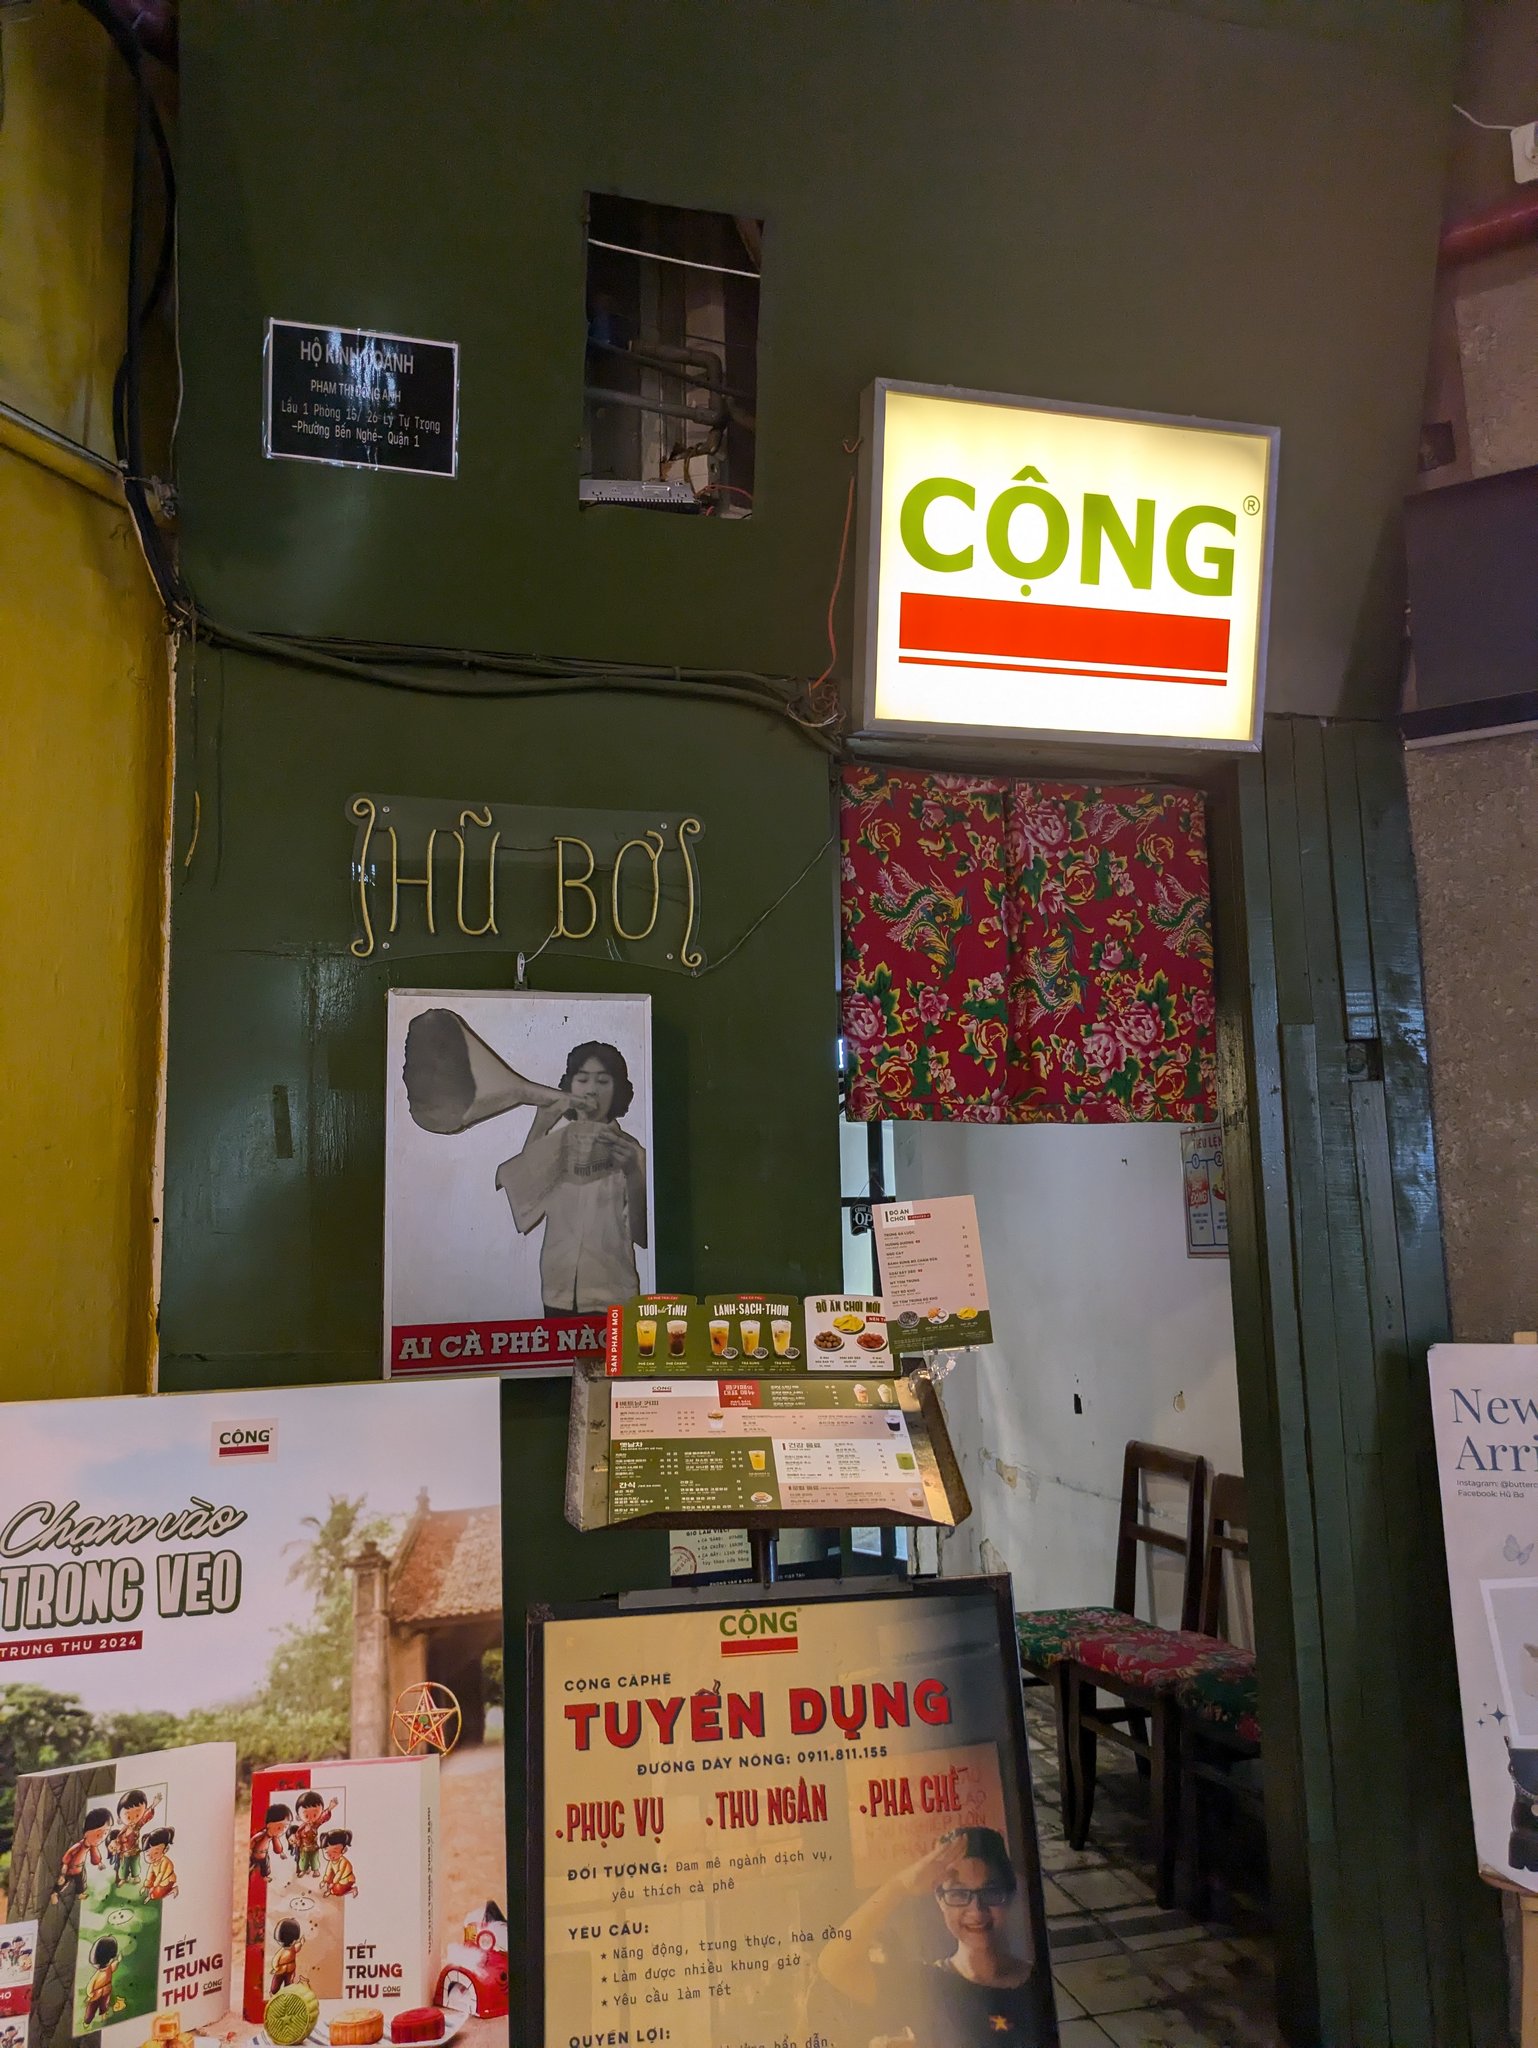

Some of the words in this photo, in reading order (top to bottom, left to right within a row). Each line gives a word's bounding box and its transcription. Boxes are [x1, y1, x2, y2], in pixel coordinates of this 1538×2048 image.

[300, 337, 322, 367] HỘ
[311, 380, 337, 397] PHẠM
[303, 403, 309, 415] 1
[313, 404, 341, 421] Phòng
[415, 416, 441, 434] Trọng
[335, 422, 351, 439] Bến
[388, 431, 409, 448] Quận
[414, 435, 420, 447] 1
[900, 465, 1236, 597] CỘNG
[399, 1337, 432, 1360] AI
[440, 1329, 483, 1358] CÀ
[491, 1325, 549, 1354] PHÊ
[220, 1428, 269, 1447] CỘNG
[0, 1499, 158, 1558] Chạm
[157, 1496, 248, 1542] vào
[0, 1556, 145, 1632] TRONG
[157, 1549, 242, 1618] VEO
[720, 1609, 797, 1638] CỘNG
[0, 1641, 54, 1658] TRUNG
[61, 1638, 93, 1652] THU
[100, 1635, 137, 1650] 2024
[564, 1680, 766, 1751] TUYỂN
[789, 1678, 952, 1741] DỤNG
[797, 1745, 888, 1764] 0911.811.155
[715, 1789, 759, 1829] THU
[767, 1776, 828, 1826] NGÂN
[868, 1777, 915, 1818] PHA
[920, 1765, 968, 1814] CHẾ
[566, 1800, 625, 1848] PHỤC
[633, 1797, 665, 1844] VỤ
[604, 1861, 668, 1878] TƯỢNG:
[676, 1861, 699, 1872] Đam
[706, 1857, 721, 1869] mê
[729, 1853, 766, 1870] ngành
[774, 1851, 805, 1865] dịch
[812, 1851, 833, 1863] vụ,
[612, 1887, 635, 1903] yêu
[643, 1883, 681, 1897] thích
[689, 1880, 704, 1894] cà
[712, 1877, 735, 1893] phê
[164, 1934, 197, 1962] TẾT
[346, 1938, 376, 1959] TẾT
[613, 1946, 644, 1960] Năng
[652, 1942, 689, 1958] động,
[699, 1939, 737, 1951] trung
[744, 1934, 782, 1948] thực,
[791, 1931, 814, 1943] hòa
[822, 1924, 852, 1941] đồng
[163, 1953, 223, 1984] TRUNG
[345, 1963, 402, 1979] TRUNG
[613, 1969, 637, 1983] Làm
[645, 1967, 676, 1981] được
[684, 1958, 723, 1976] nhiều
[731, 1959, 769, 1972] khung
[777, 1953, 801, 1970] giờ
[162, 1981, 199, 2008] THU
[345, 1984, 379, 1999] THU
[613, 1992, 637, 2006] Yêu
[645, 1987, 669, 2003] cầu
[678, 1987, 701, 2000] làm
[708, 1980, 732, 1997] Tết
[636, 2027, 671, 2043] LỢI:
